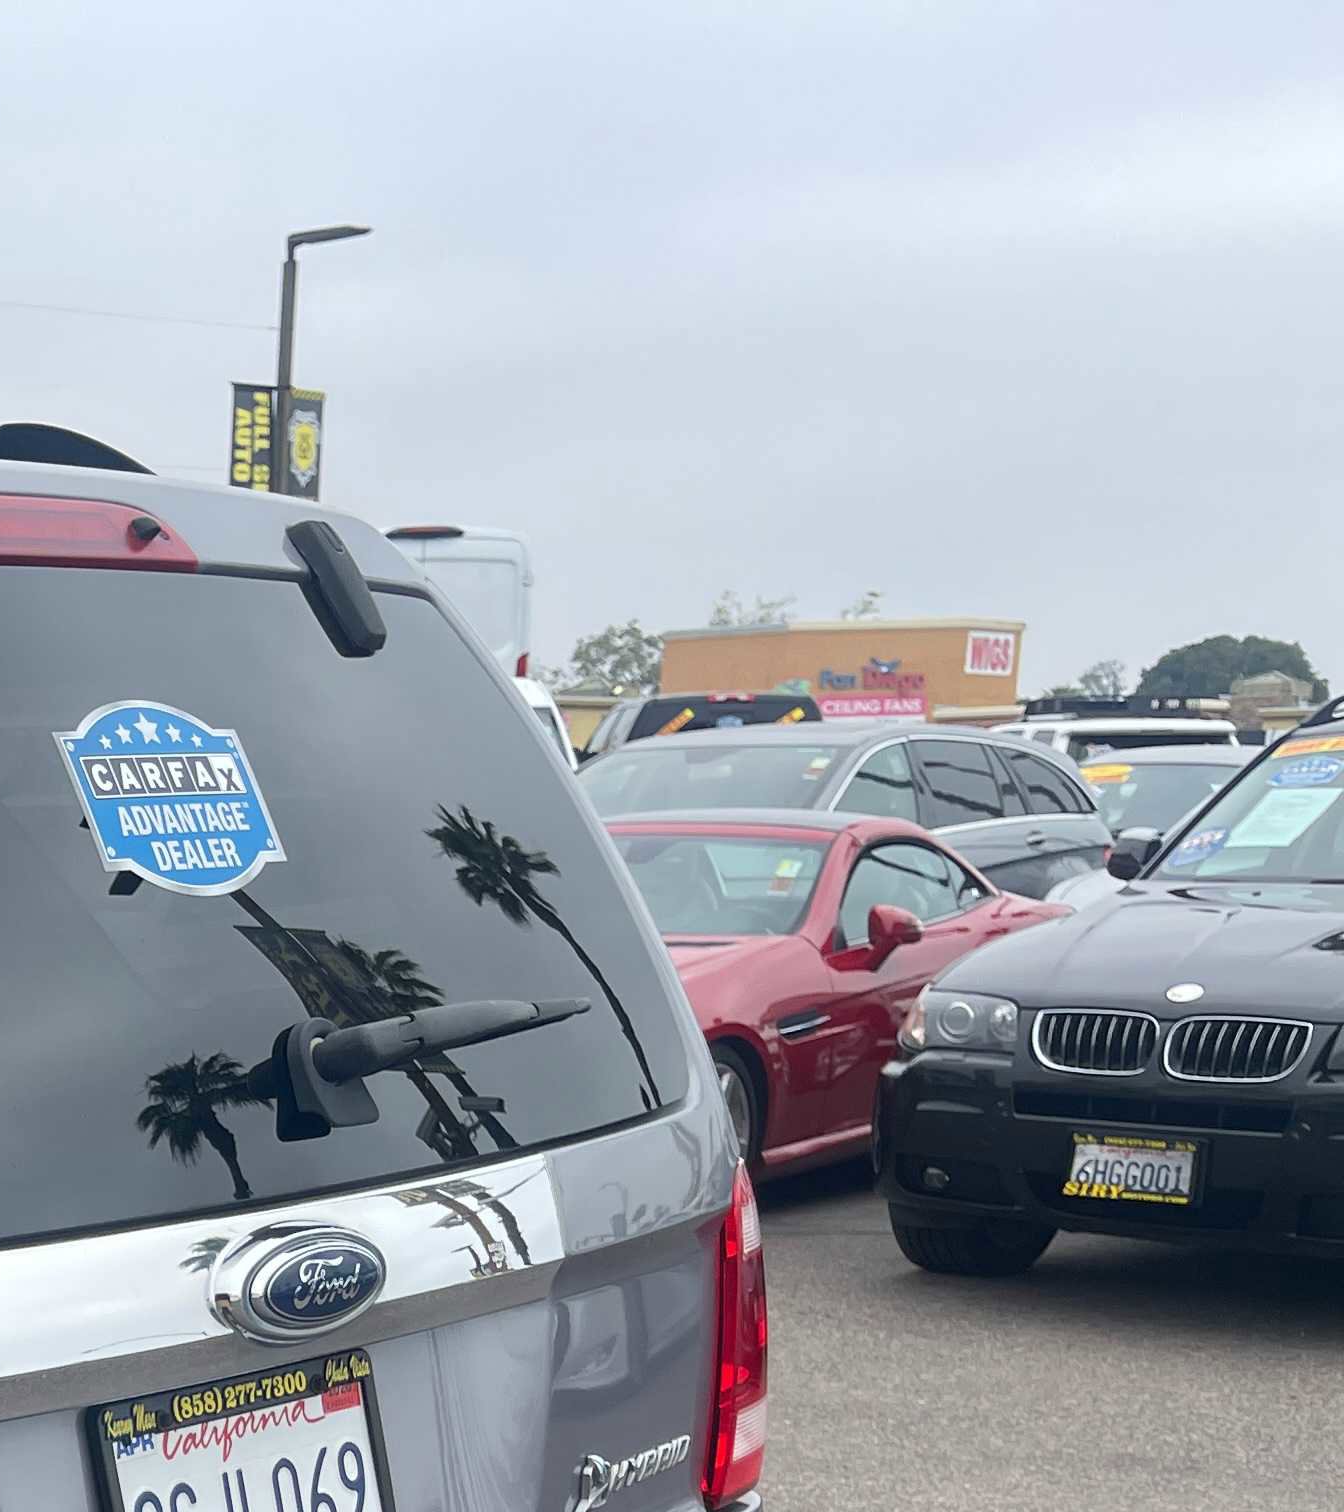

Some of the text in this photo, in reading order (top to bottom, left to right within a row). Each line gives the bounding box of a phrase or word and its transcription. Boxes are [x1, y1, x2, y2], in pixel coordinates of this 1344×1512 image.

[233, 407, 252, 482] AUTO
[972, 637, 1010, 671] WIGS
[823, 698, 922, 714] CEILING FANS
[91, 760, 242, 792] CARFAX
[117, 802, 250, 837] ADVANTAGE
[150, 838, 243, 872] DEALER
[1063, 1180, 1125, 1199] SIRY
[1076, 1159, 1185, 1193] 6HGG001
[293, 1255, 361, 1310] Ford
[173, 1387, 223, 1422] (858)
[225, 1371, 308, 1406] 277-7300
[115, 1433, 155, 1460] APR
[162, 1400, 326, 1462] California
[608, 1434, 691, 1492] HYBRID
